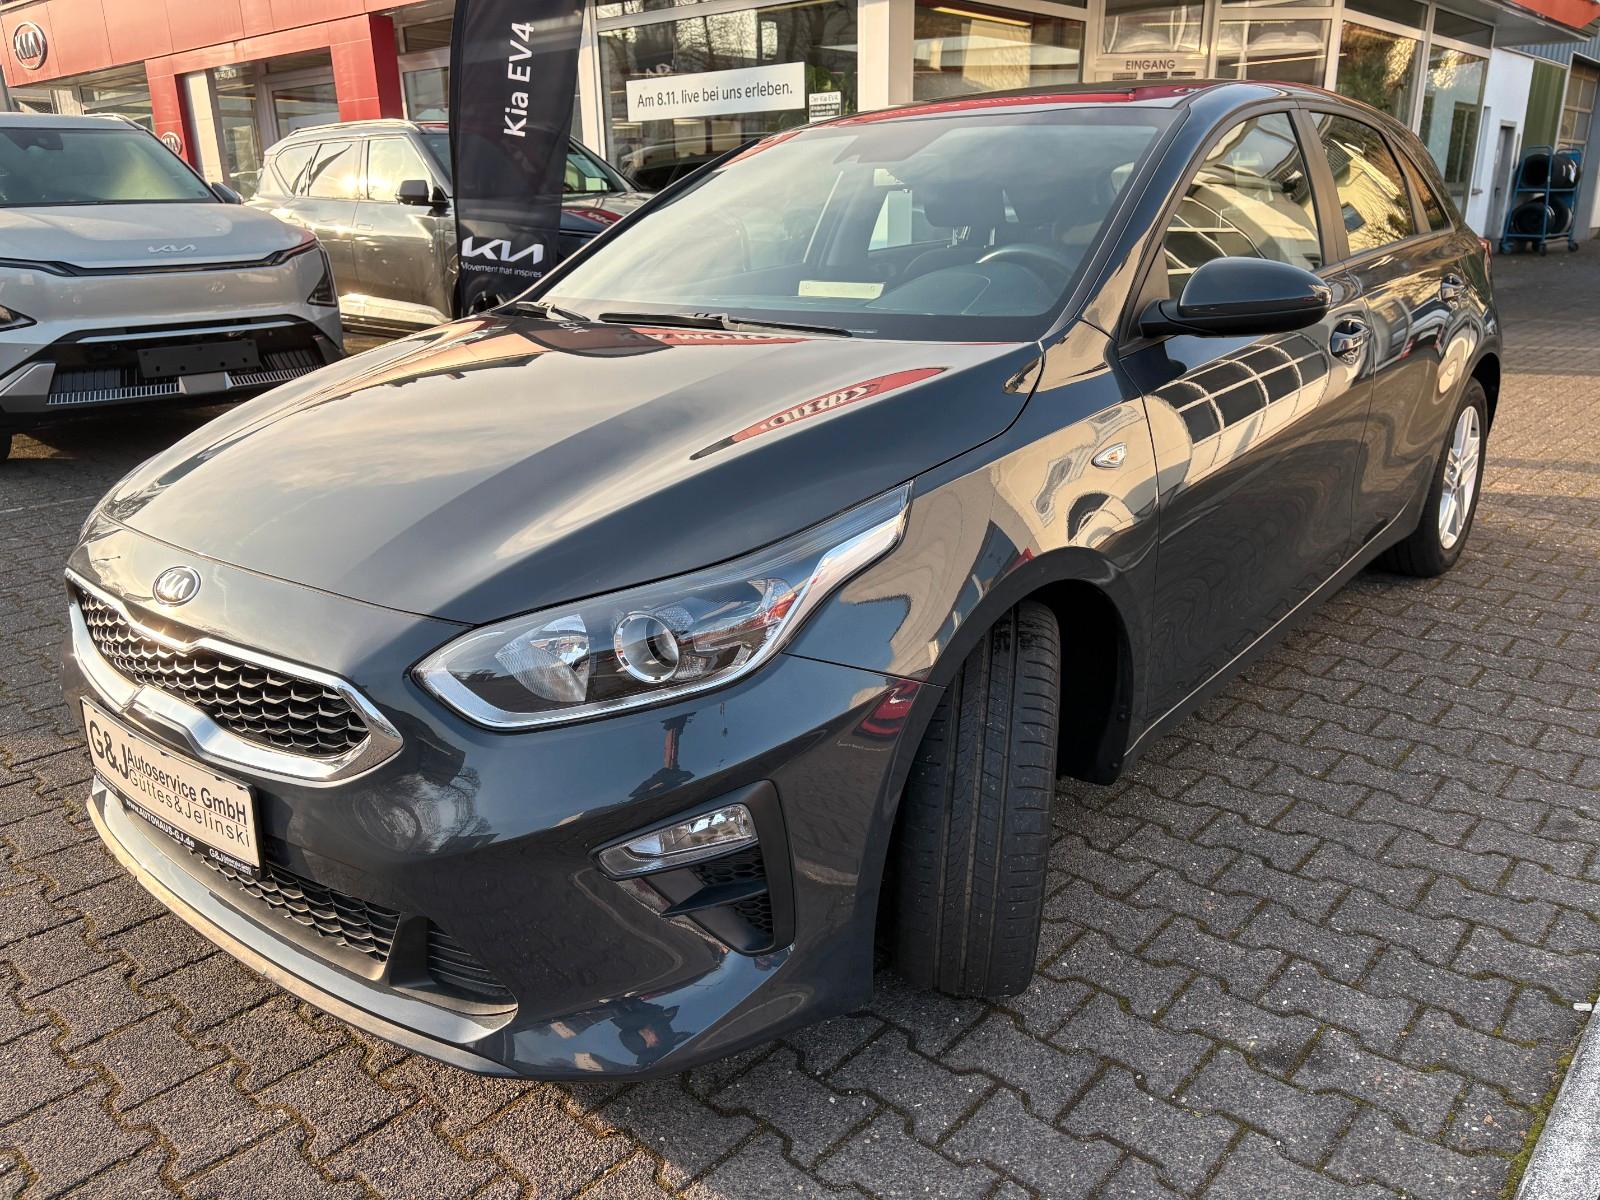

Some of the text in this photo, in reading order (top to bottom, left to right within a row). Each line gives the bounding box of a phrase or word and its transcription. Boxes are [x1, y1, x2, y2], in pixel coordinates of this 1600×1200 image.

[14, 29, 43, 61] KIA
[503, 22, 535, 137] Kia EV4
[1125, 59, 1176, 71] EINGANG
[637, 81, 793, 108] Am 8.11. live bei uns erleben.
[461, 236, 545, 265] KIA
[460, 261, 542, 278] Movement that inspires
[156, 571, 193, 601] KIA
[89, 719, 129, 780] G&J
[128, 747, 197, 802] Autoservice
[200, 787, 248, 826] GmbH
[126, 799, 196, 848] www.AUTOHAUS-GJ.de
